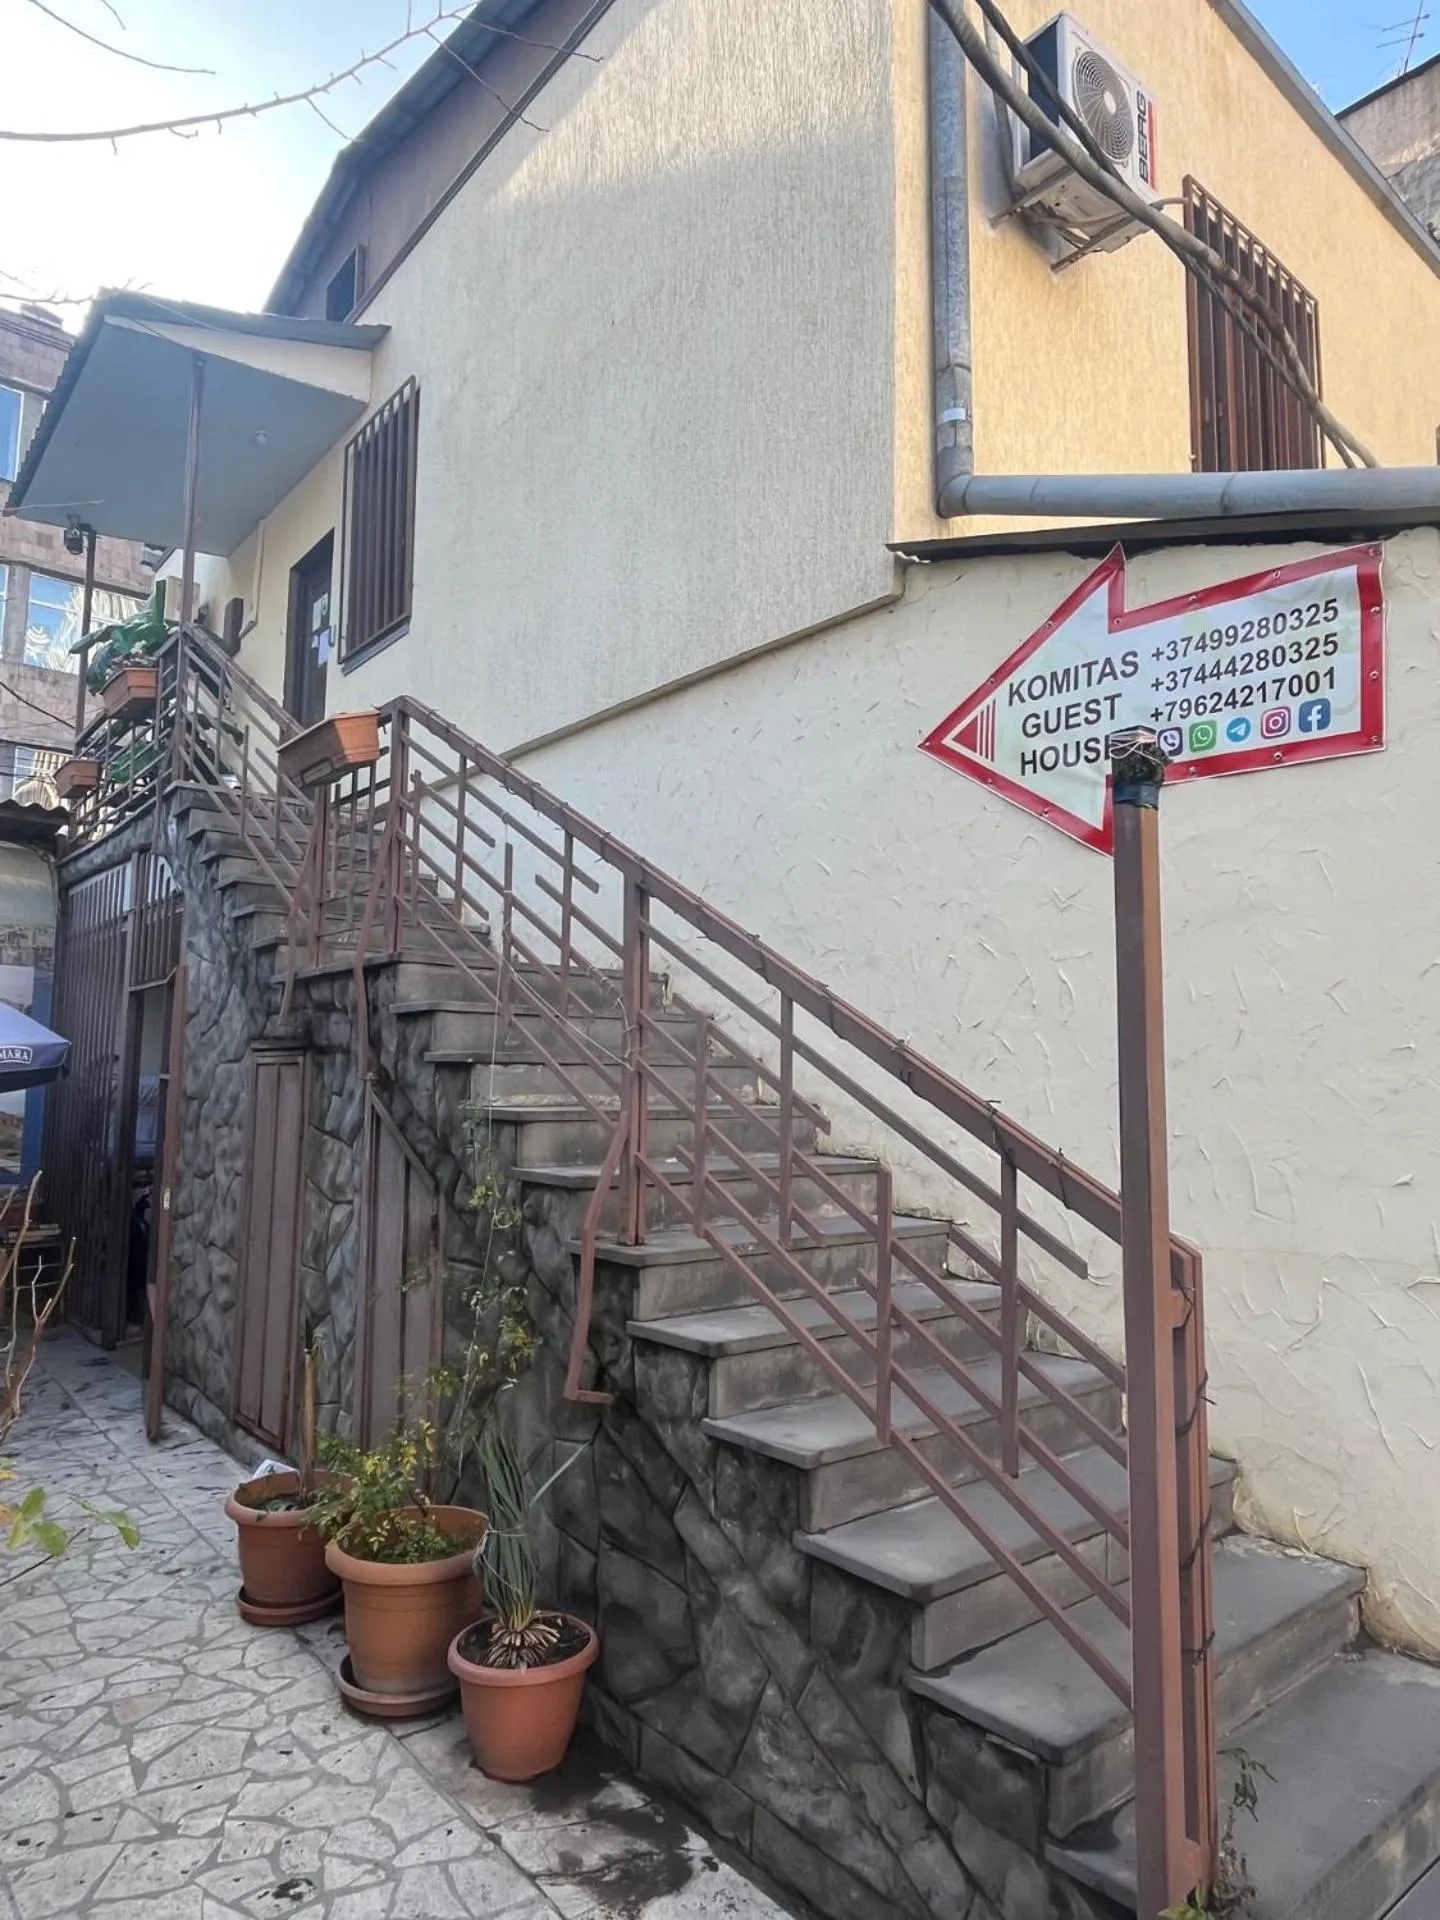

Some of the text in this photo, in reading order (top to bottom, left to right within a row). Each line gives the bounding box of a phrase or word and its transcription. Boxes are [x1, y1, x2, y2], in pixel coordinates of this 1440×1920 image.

[1137, 90, 1149, 184] BERG
[1151, 598, 1339, 661] +37499280325
[1008, 650, 1139, 706] KOMITAS
[1150, 632, 1339, 692] +37444280325
[1021, 692, 1122, 738] GUEST
[1150, 666, 1335, 722] +79624217001
